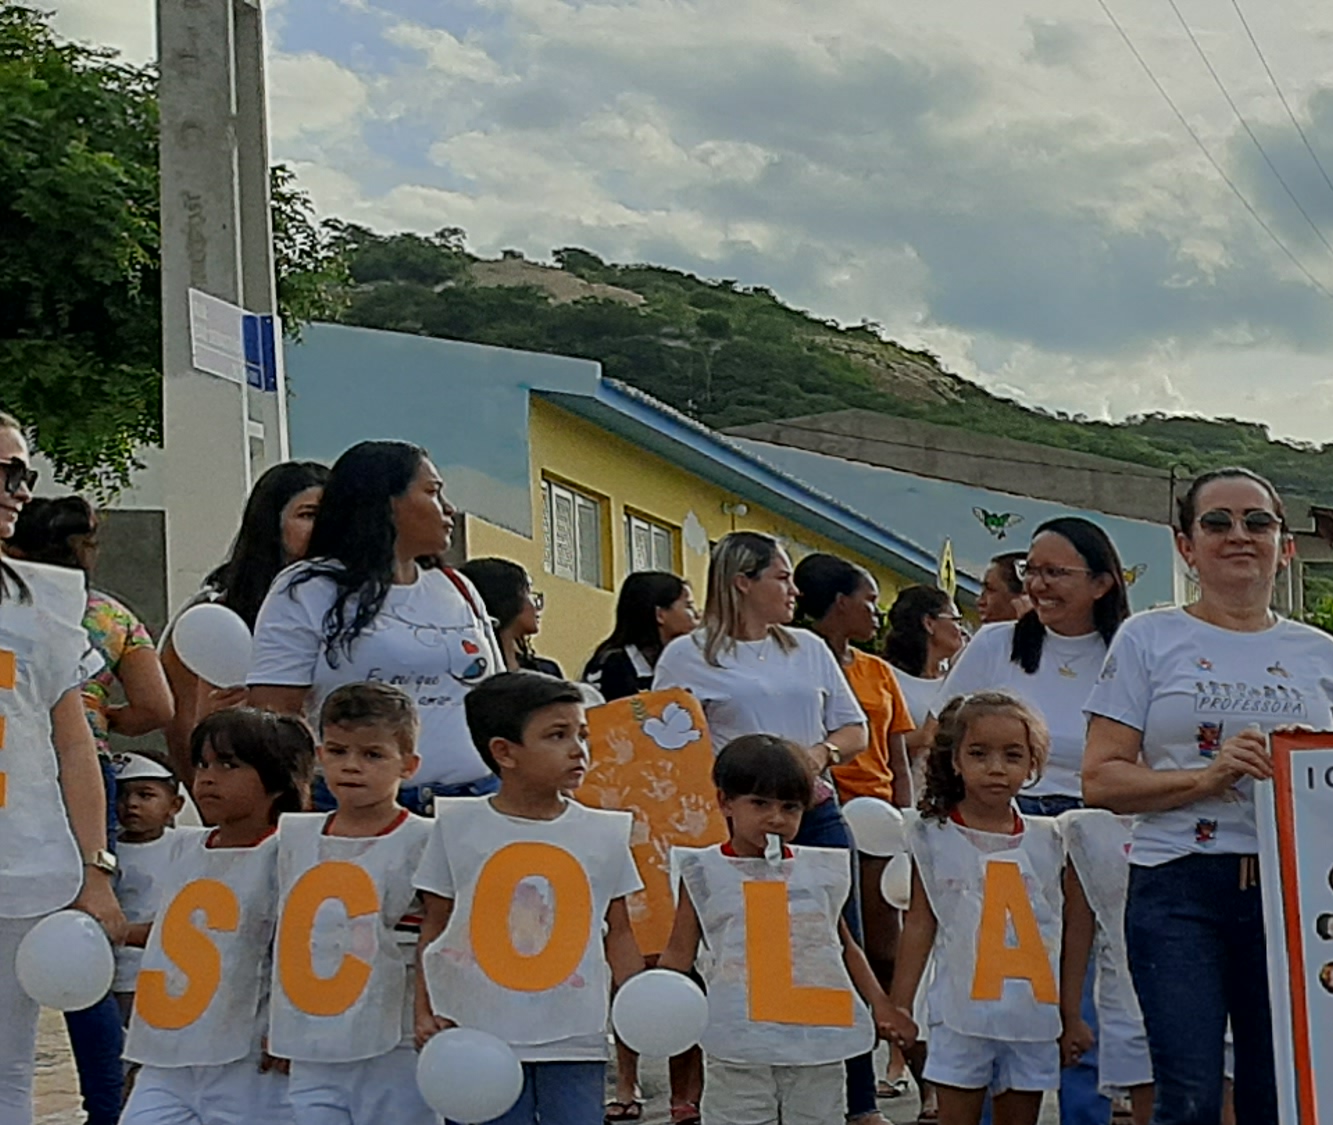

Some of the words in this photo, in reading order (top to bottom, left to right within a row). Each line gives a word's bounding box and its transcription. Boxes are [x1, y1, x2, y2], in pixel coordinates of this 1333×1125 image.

[1198, 696, 1302, 713] PROFESSORA
[1307, 767, 1315, 789] I
[134, 879, 239, 1029] S
[279, 861, 379, 1016] C
[470, 842, 592, 992] O
[742, 881, 854, 1027] L
[971, 861, 1059, 1004] A
